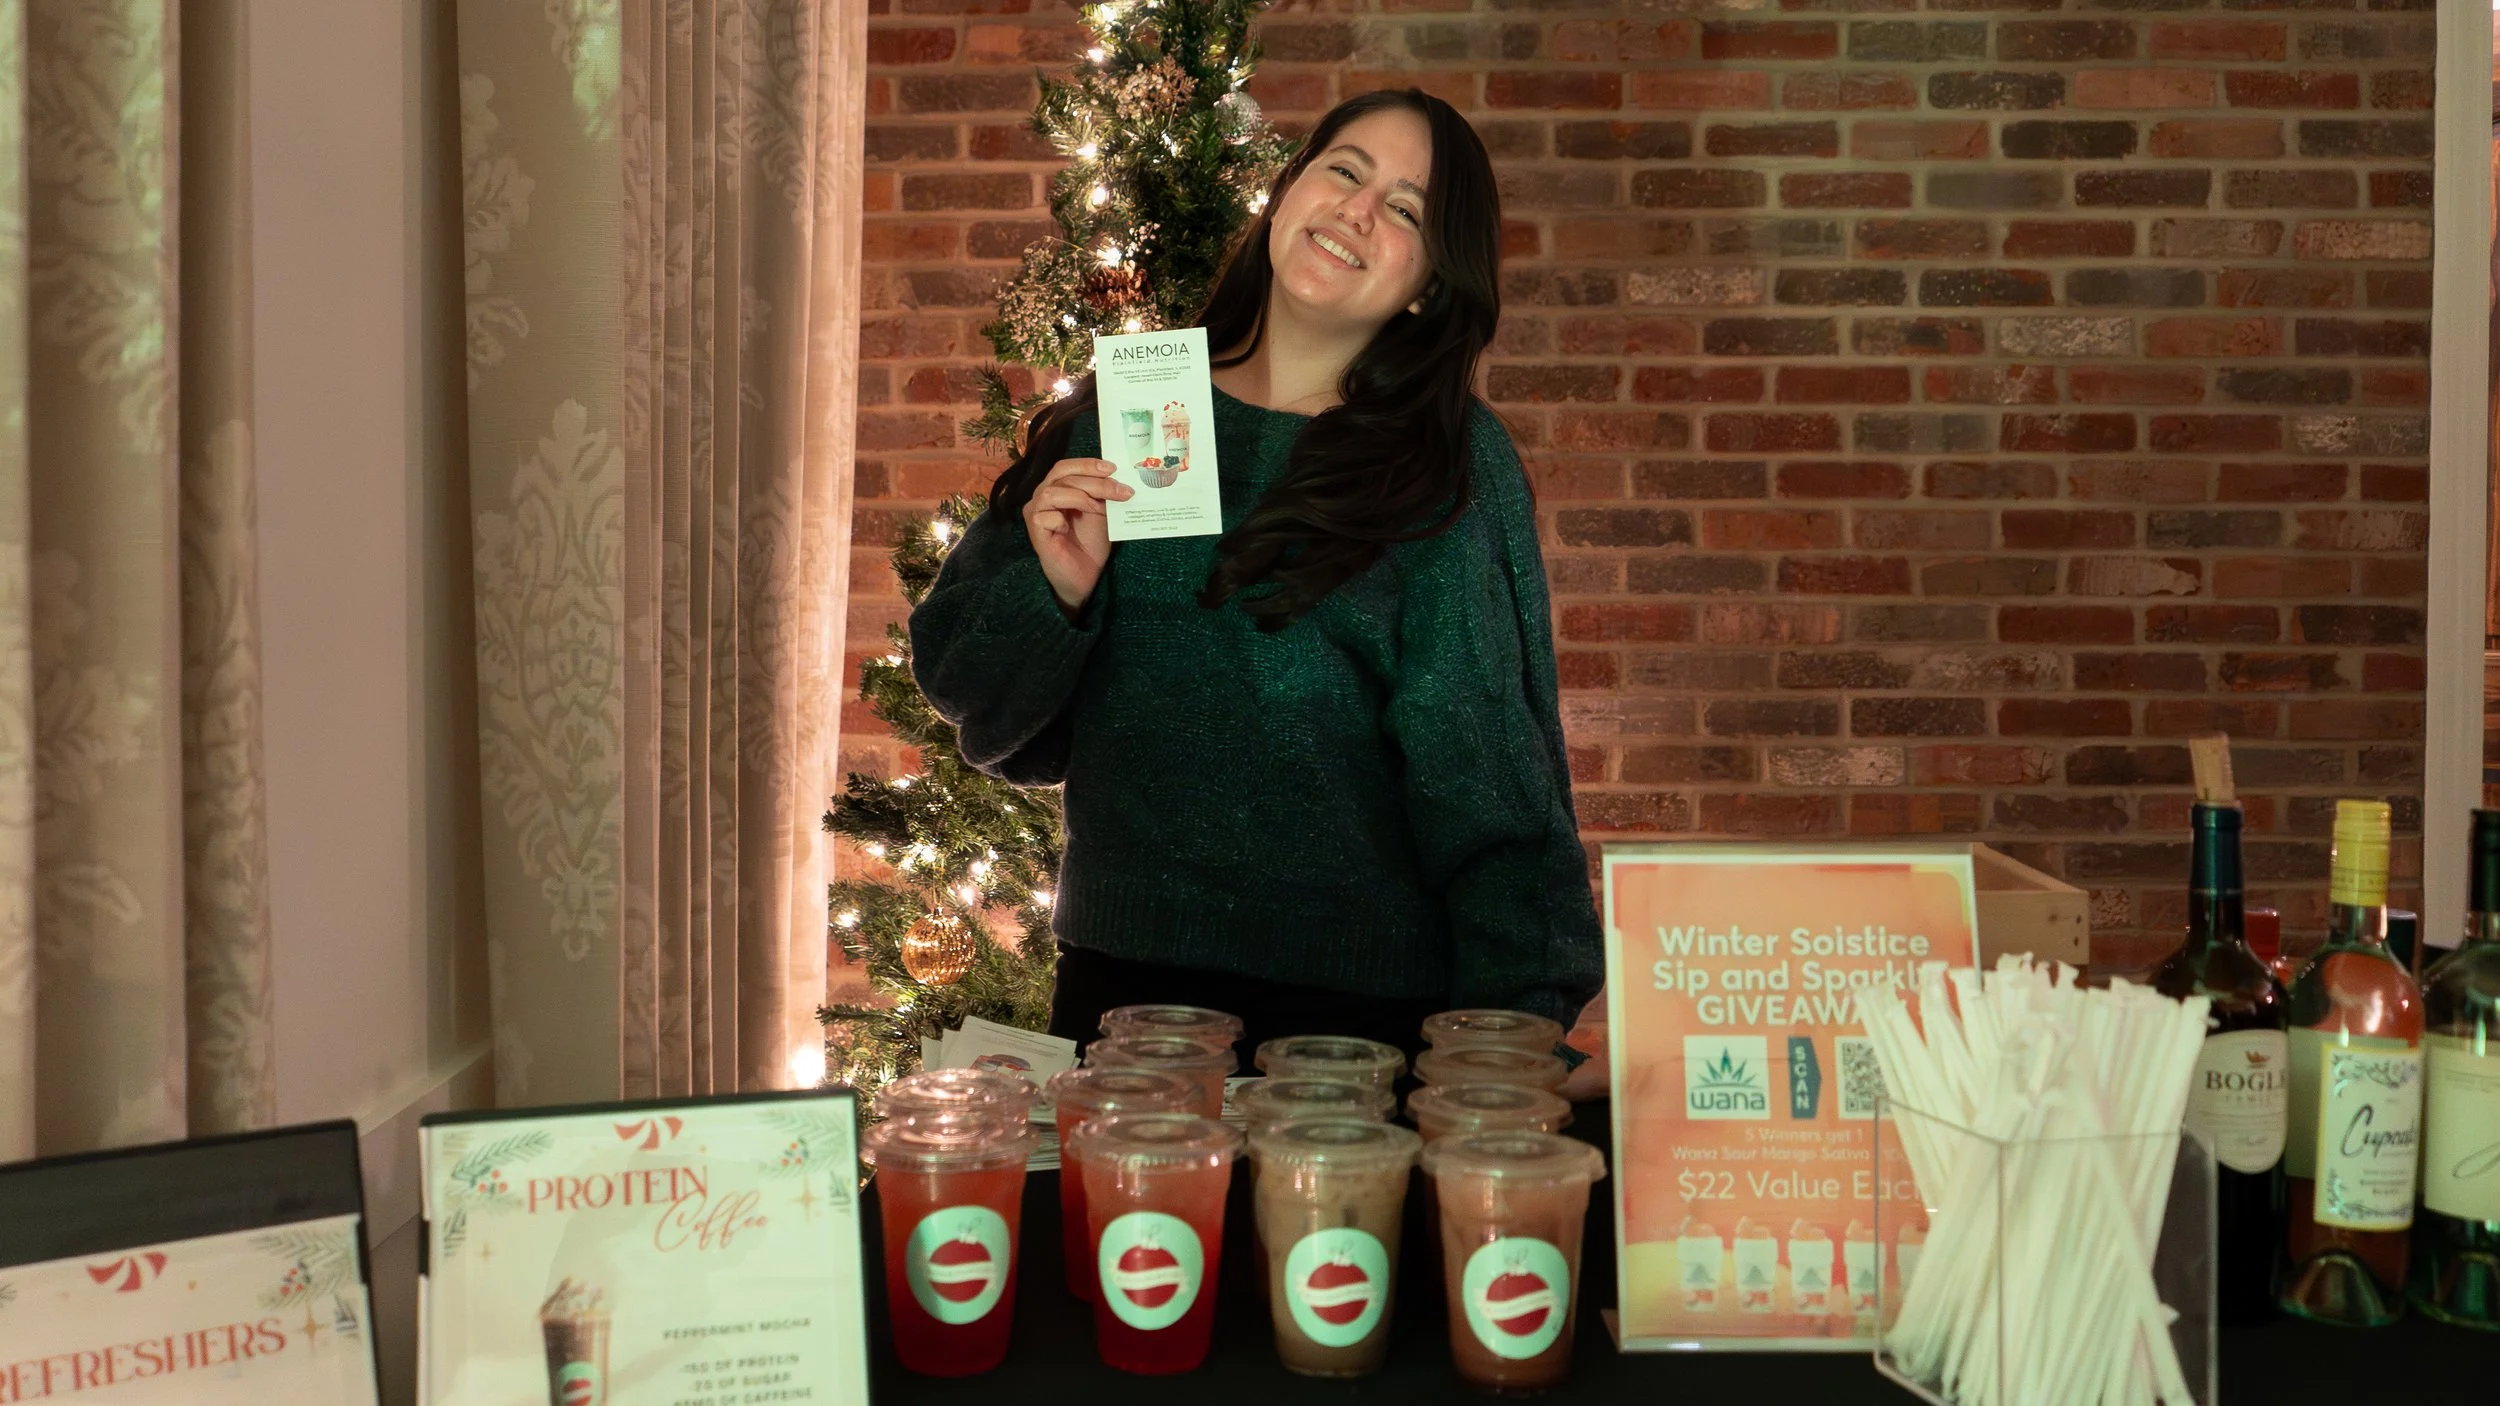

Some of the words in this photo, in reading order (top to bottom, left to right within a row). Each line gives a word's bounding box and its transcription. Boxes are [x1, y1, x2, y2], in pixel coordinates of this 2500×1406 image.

[1112, 343, 1190, 360] ANEMOIA
[1657, 925, 1779, 956] Winter
[1790, 925, 1930, 957] Solstice
[1653, 960, 1710, 998] Sip
[1720, 960, 1790, 991] and
[1801, 959, 1918, 1000] Sparkl
[1794, 1045, 1810, 1109] SCAN
[1690, 1091, 1766, 1111] wana
[1760, 1127, 1820, 1143] Winners
[1826, 1129, 1850, 1146] get
[1671, 1145, 1718, 1161] Wana
[1722, 1145, 1757, 1161] Sour
[1763, 1146, 1818, 1165] Mango
[1822, 1147, 1871, 1161] Sativa
[528, 1165, 708, 1215] PROTEIN
[1677, 1167, 1737, 1203] $22
[1746, 1170, 1841, 1200] Value
[653, 1188, 768, 1252] Coffee
[662, 1322, 755, 1341] PEPPERMINT
[759, 1316, 811, 1332] MOCHA
[737, 1352, 799, 1369] PROTEIN
